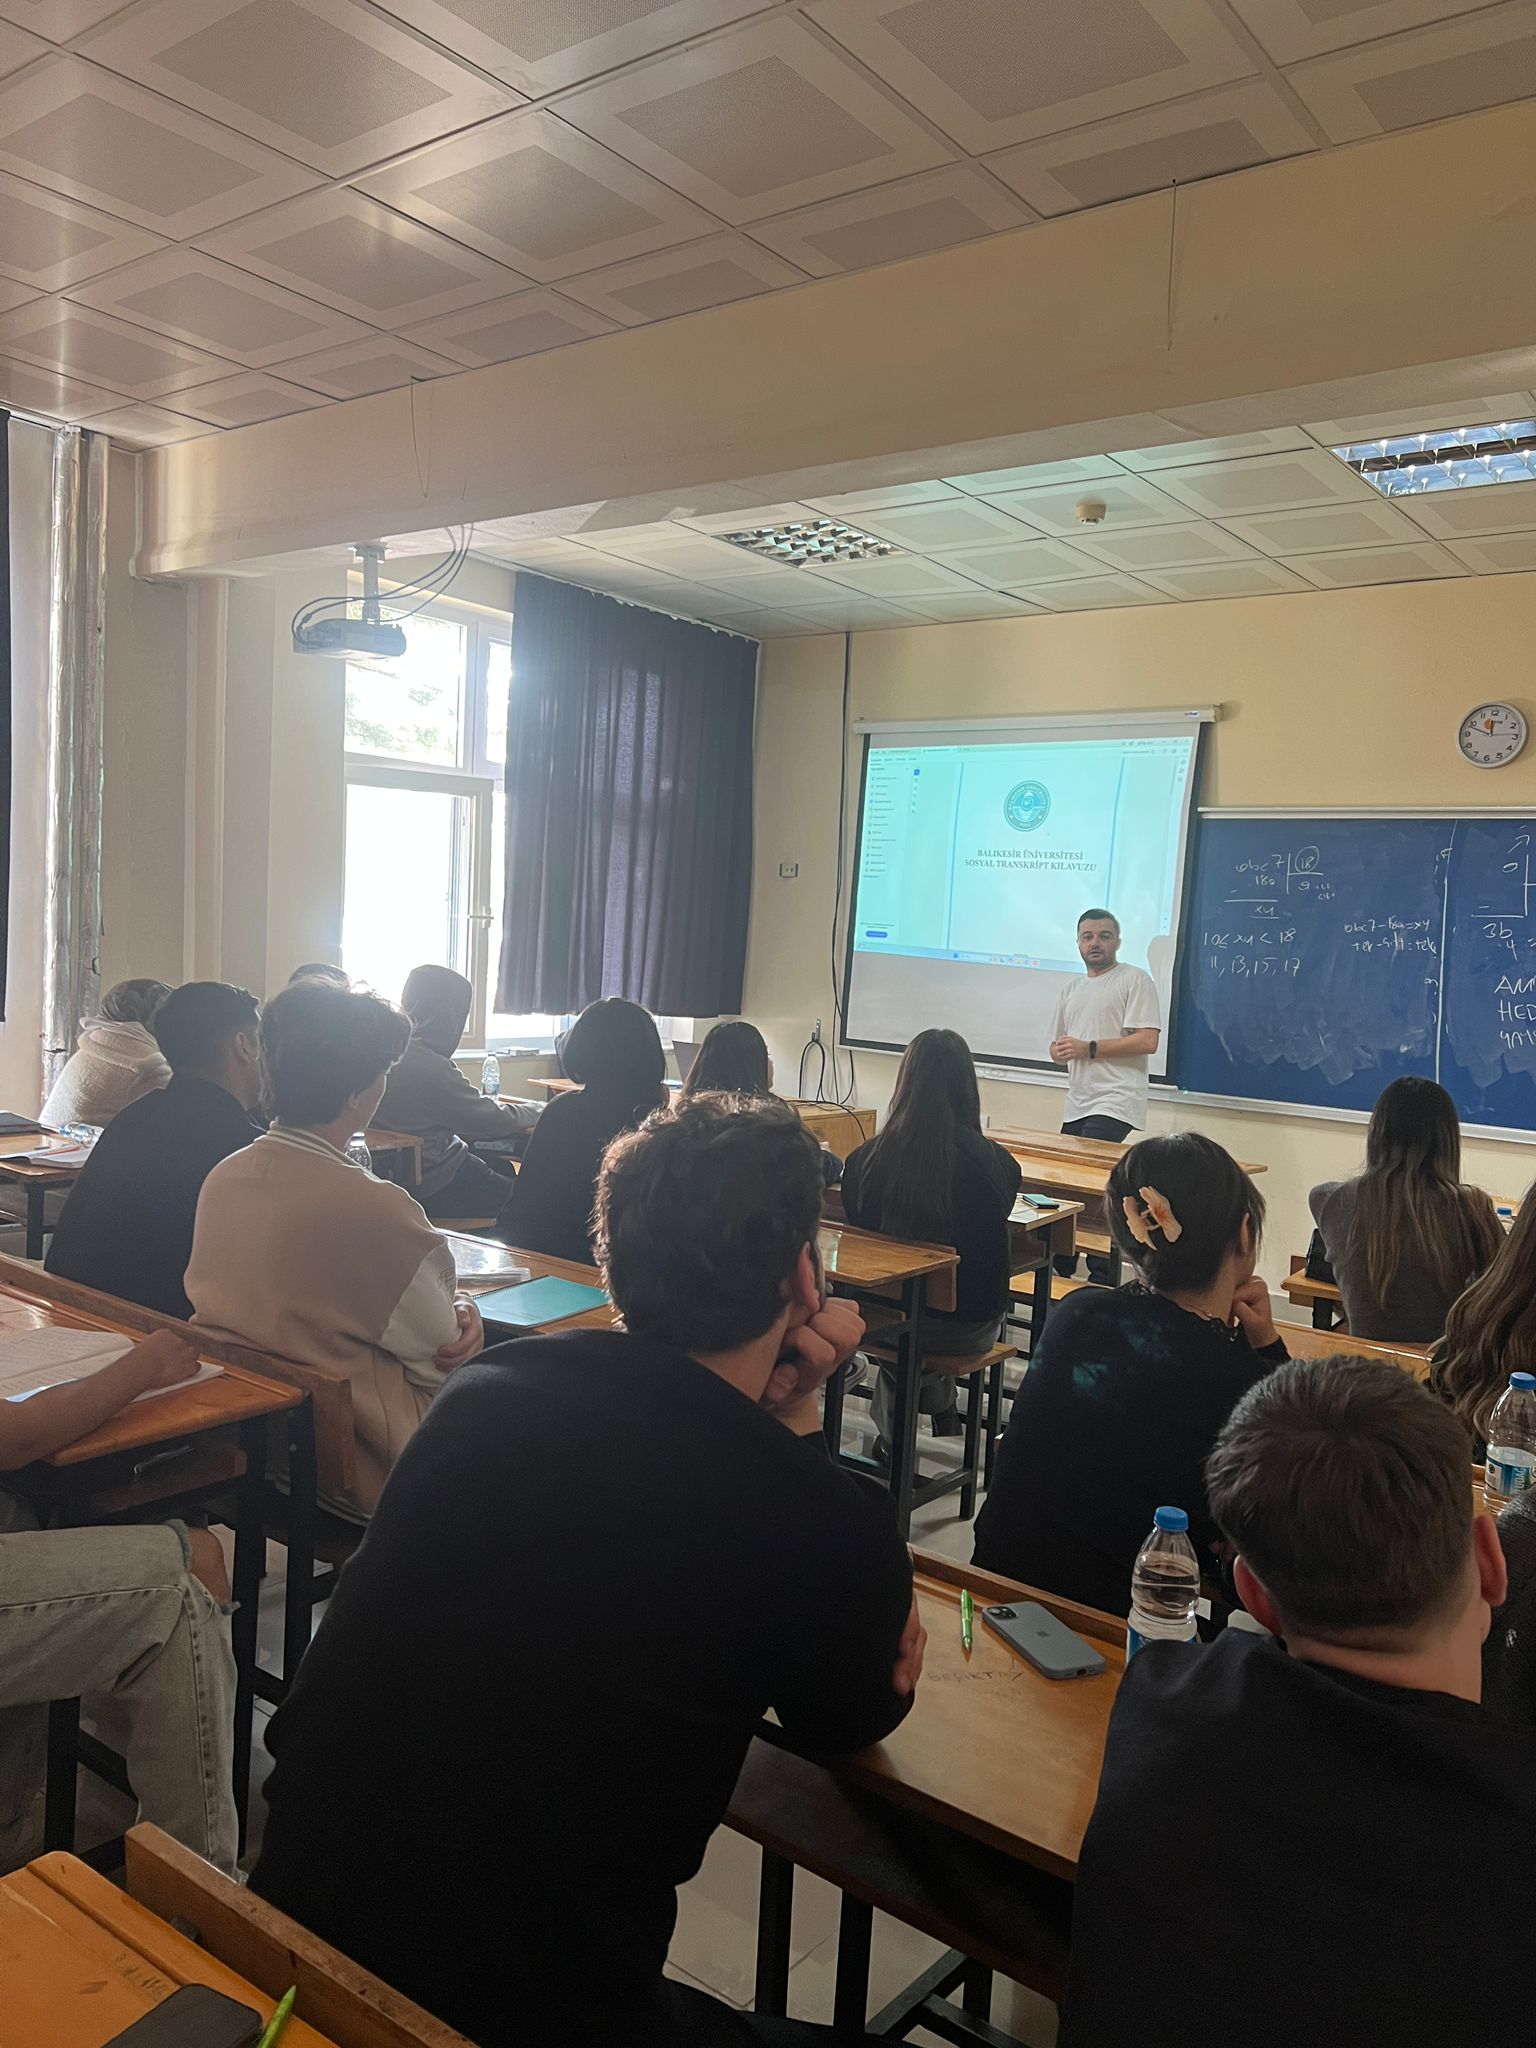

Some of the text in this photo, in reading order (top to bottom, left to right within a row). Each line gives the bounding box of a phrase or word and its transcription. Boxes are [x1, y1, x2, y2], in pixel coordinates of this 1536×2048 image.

[1491, 709, 1500, 717] 12
[1464, 730, 1471, 738] 9
[1512, 733, 1519, 741] 3
[1473, 750, 1479, 758] 7
[977, 848, 1084, 861] BALIKESİR ÜNİVERSİTESİ
[964, 859, 1097, 872] SOSYAL TRANSKRİPT KILAVUZU
[1279, 927, 1297, 944] 18
